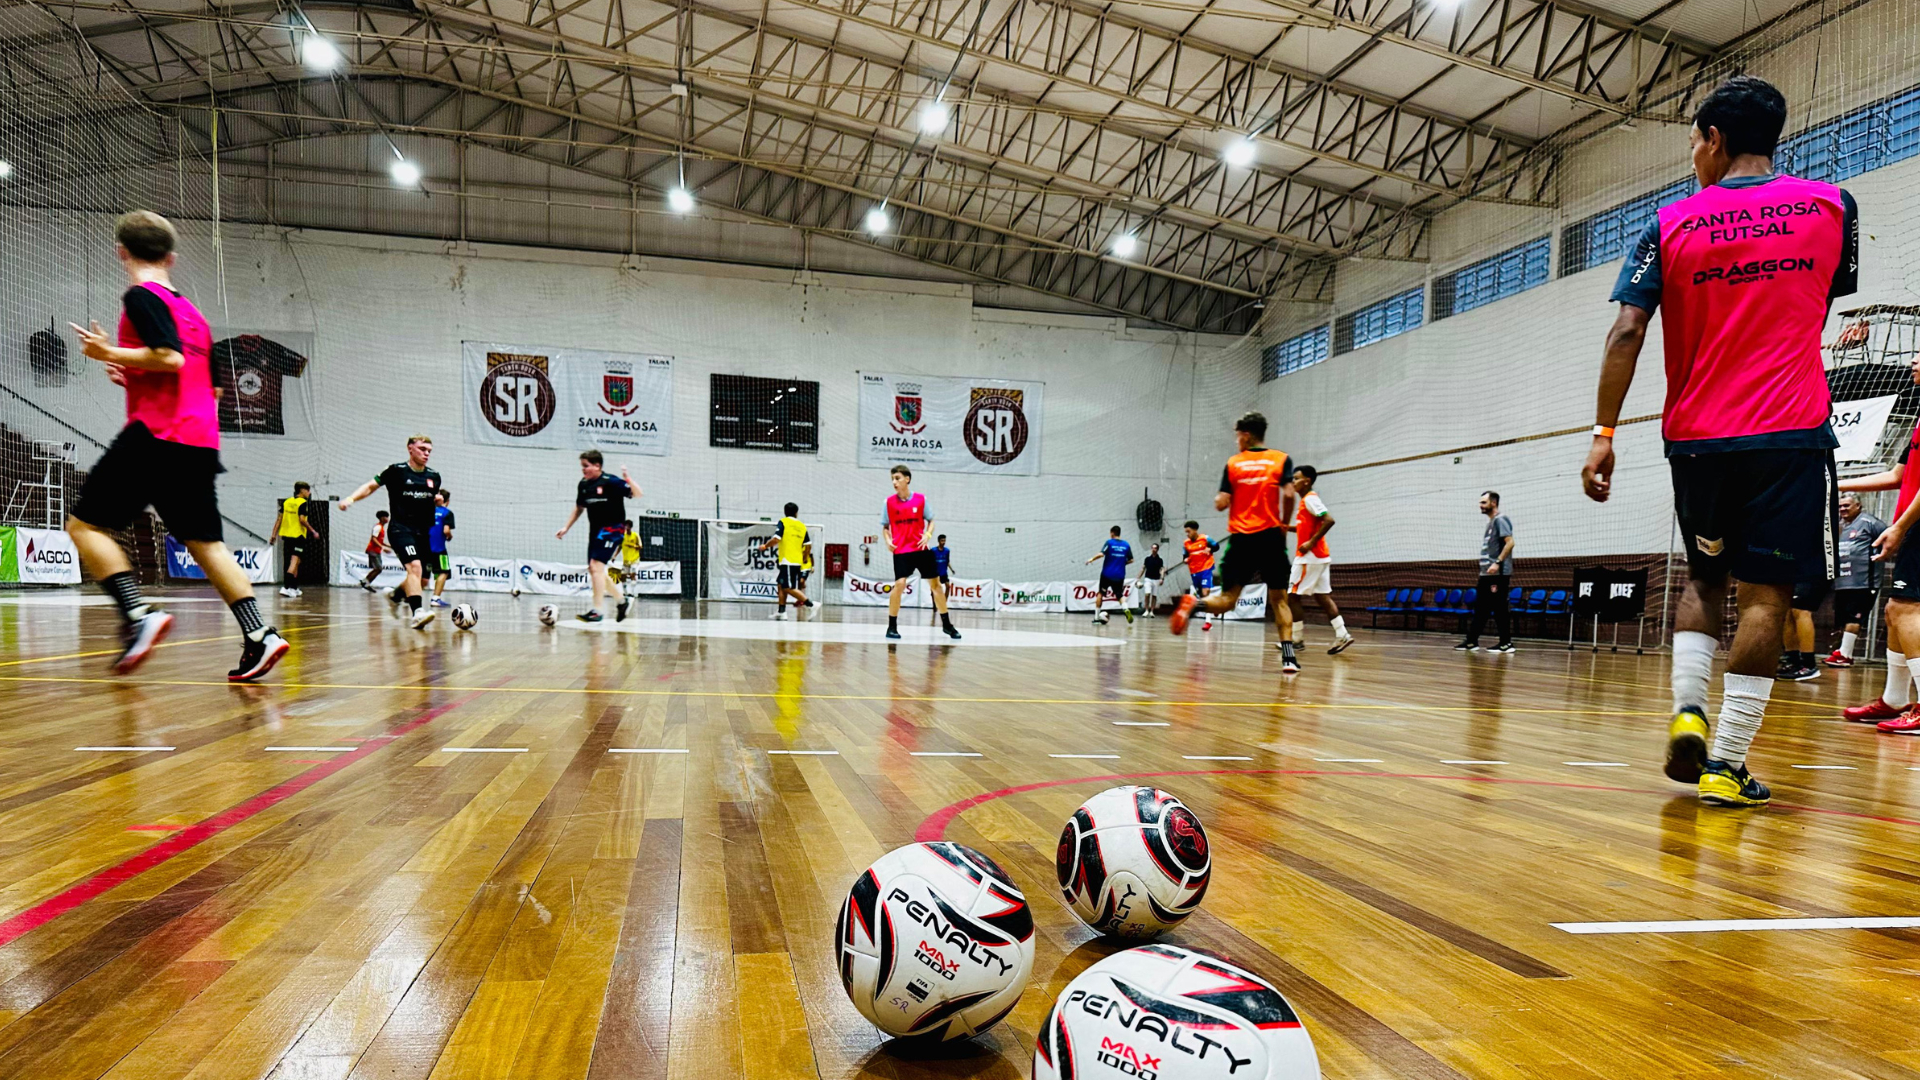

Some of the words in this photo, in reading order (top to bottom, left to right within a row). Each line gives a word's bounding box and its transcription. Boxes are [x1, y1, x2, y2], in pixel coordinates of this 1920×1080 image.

[1682, 208, 1753, 235] SANTA
[1760, 201, 1822, 220] ROSA
[1710, 221, 1794, 244] FUTSAL
[1692, 257, 1814, 286] DRÁGGON
[1729, 274, 1775, 286] SPORTS
[496, 376, 540, 424] SR
[578, 417, 619, 430] SANTA
[623, 420, 658, 432] ROSA
[1831, 411, 1862, 428] OSA
[976, 409, 1014, 453] SR
[871, 436, 909, 448] SANTA
[912, 438, 943, 449] ROSA
[38, 550, 72, 564] AGCO
[405, 545, 417, 556] 10
[456, 564, 510, 579] Tecnika
[537, 571, 556, 581] vdr
[560, 573, 588, 584] petri
[629, 570, 674, 580] HELTER
[1610, 583, 1636, 599] KIEF
[1109, 883, 1137, 931] ALTY
[887, 887, 1013, 976] PENALTY
[913, 949, 956, 981] 1000
[919, 940, 961, 973] MAX
[916, 978, 929, 989] FIFA
[889, 997, 909, 1014] SR
[1064, 989, 1252, 1075] PENALTY
[1101, 1036, 1161, 1070] MAX
[1097, 1050, 1157, 1080] 1000
